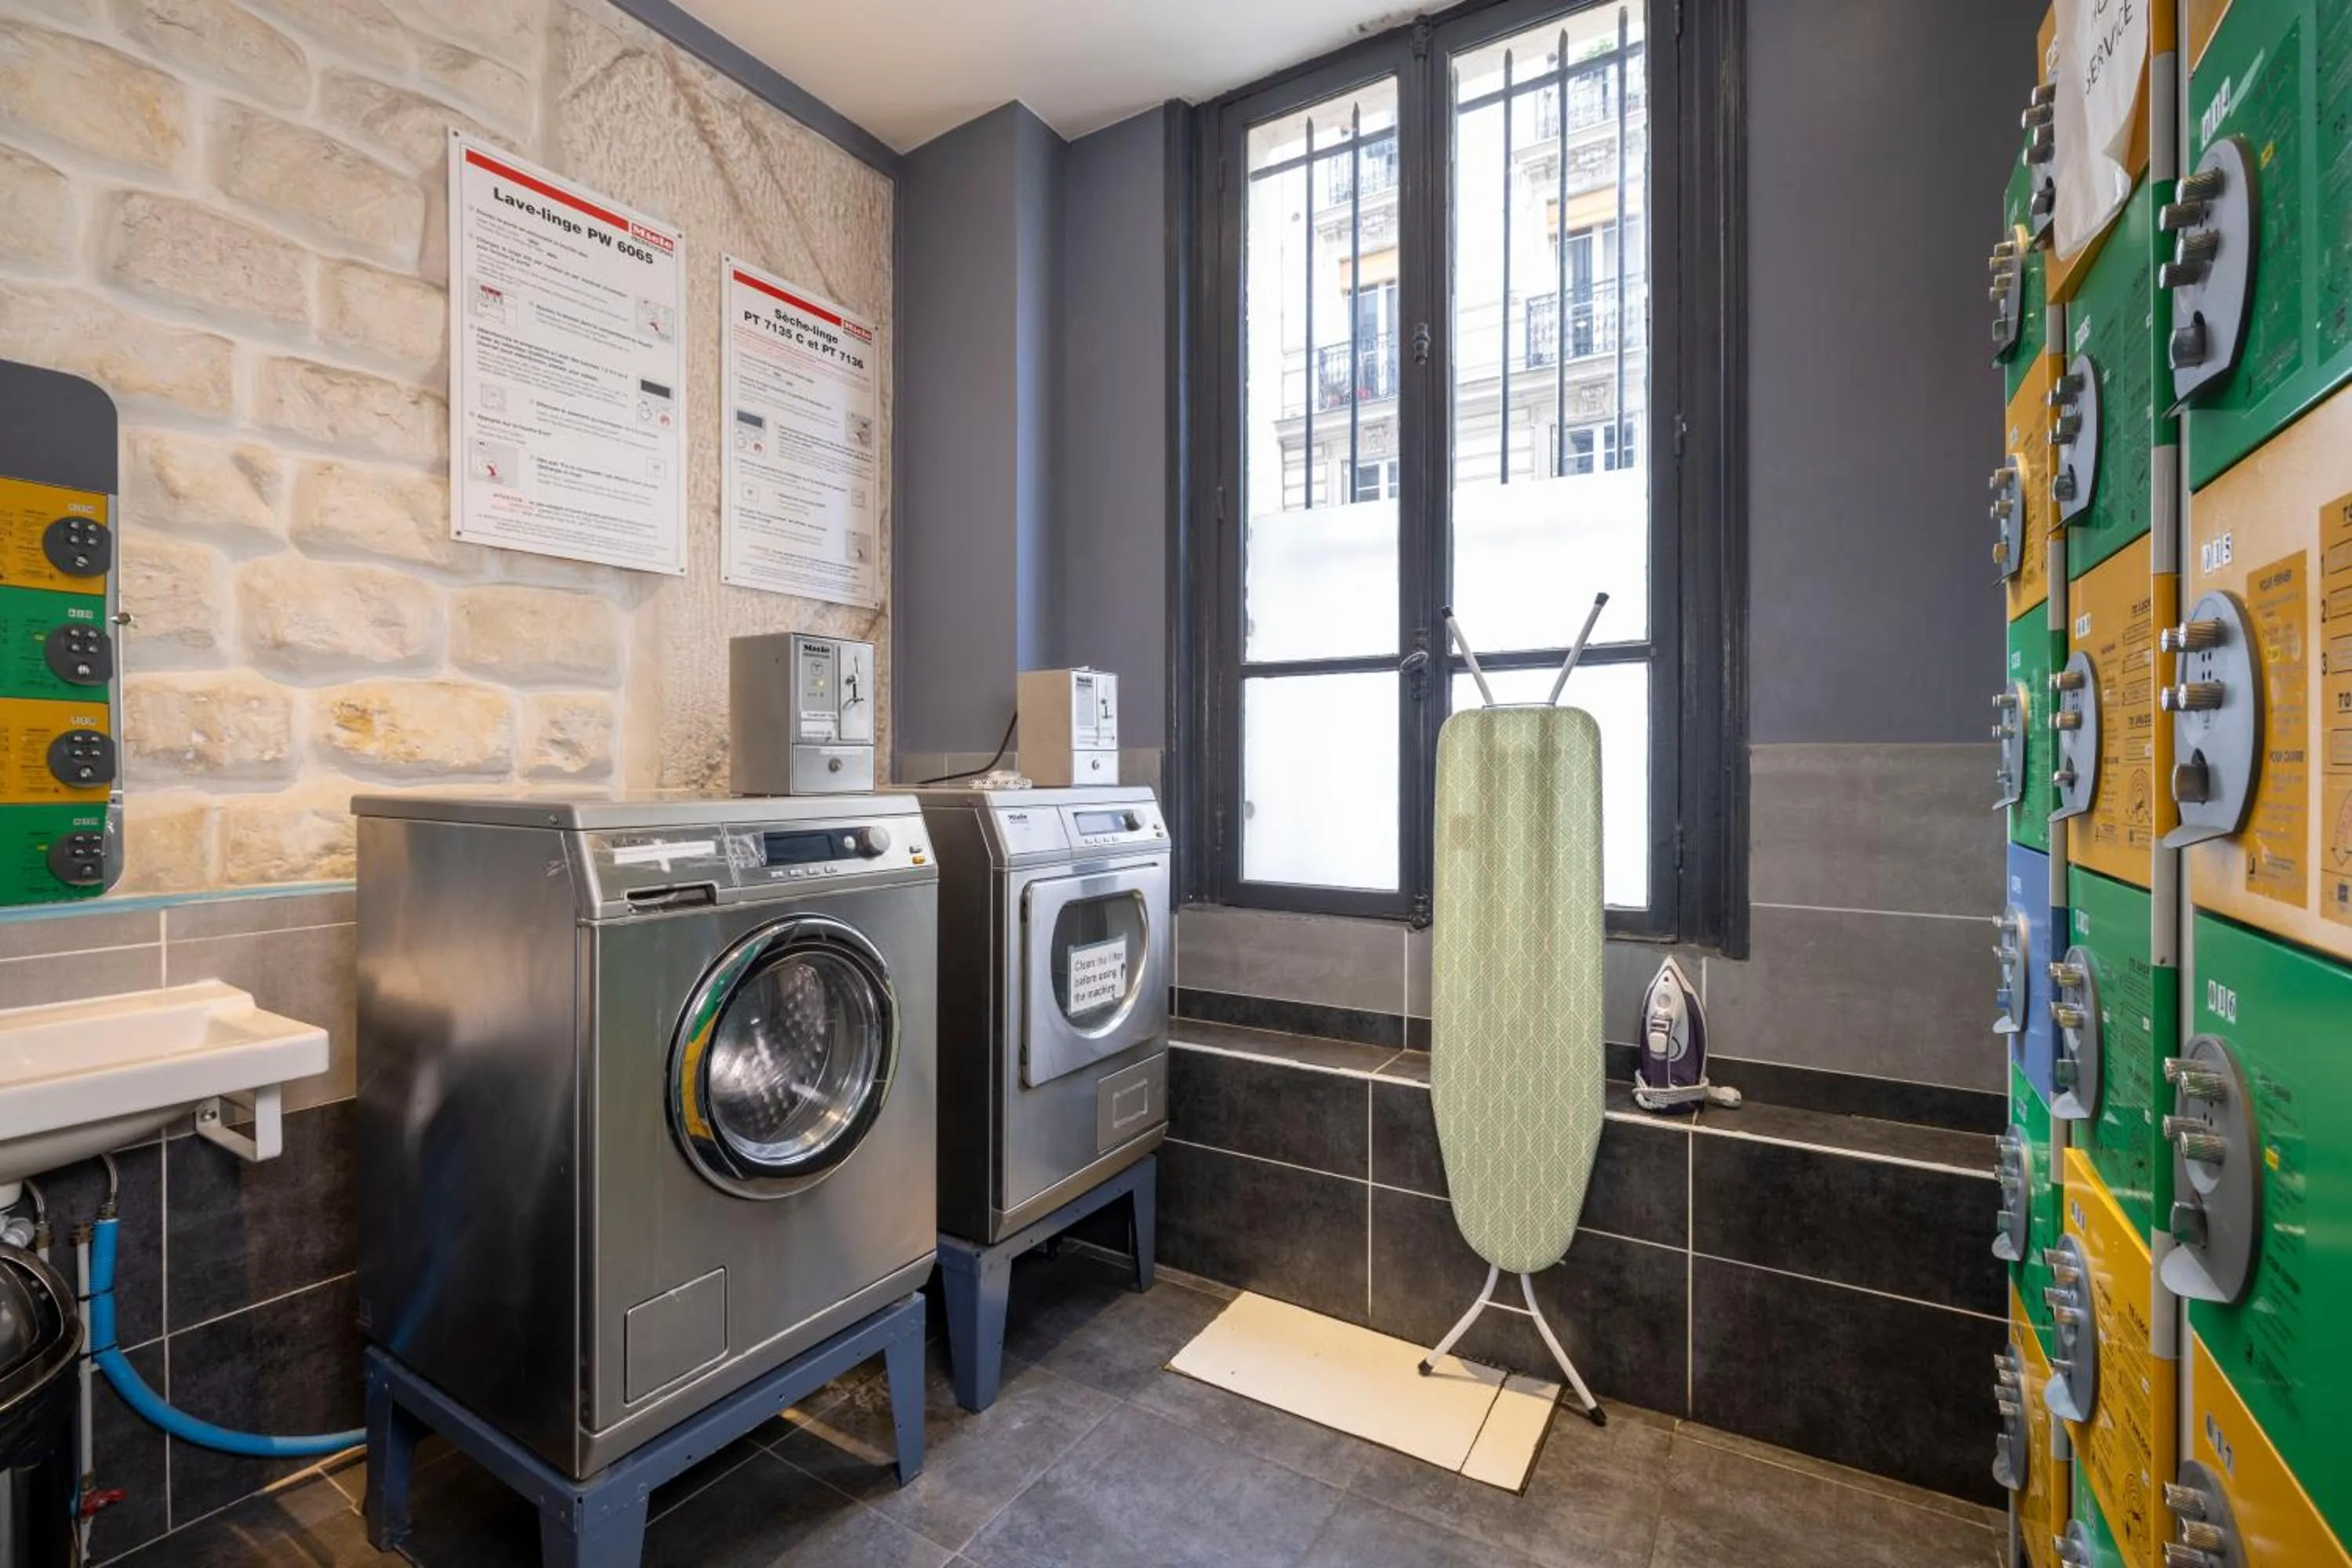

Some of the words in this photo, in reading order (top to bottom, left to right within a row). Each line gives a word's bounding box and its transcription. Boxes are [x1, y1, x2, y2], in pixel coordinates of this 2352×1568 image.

[493, 187, 582, 234] Lave-linge
[588, 227, 612, 248] PW
[618, 241, 653, 264] 6065
[744, 311, 760, 325] PT
[764, 320, 793, 339] 7135
[795, 332, 804, 343] C
[807, 338, 819, 350] et
[822, 344, 837, 358] PT
[840, 350, 864, 369] 7136
[802, 644, 831, 654] Miele
[1075, 958, 1096, 972] Clean
[1076, 974, 1097, 988] before
[1098, 969, 1117, 982] using
[1087, 984, 1116, 999] machine
